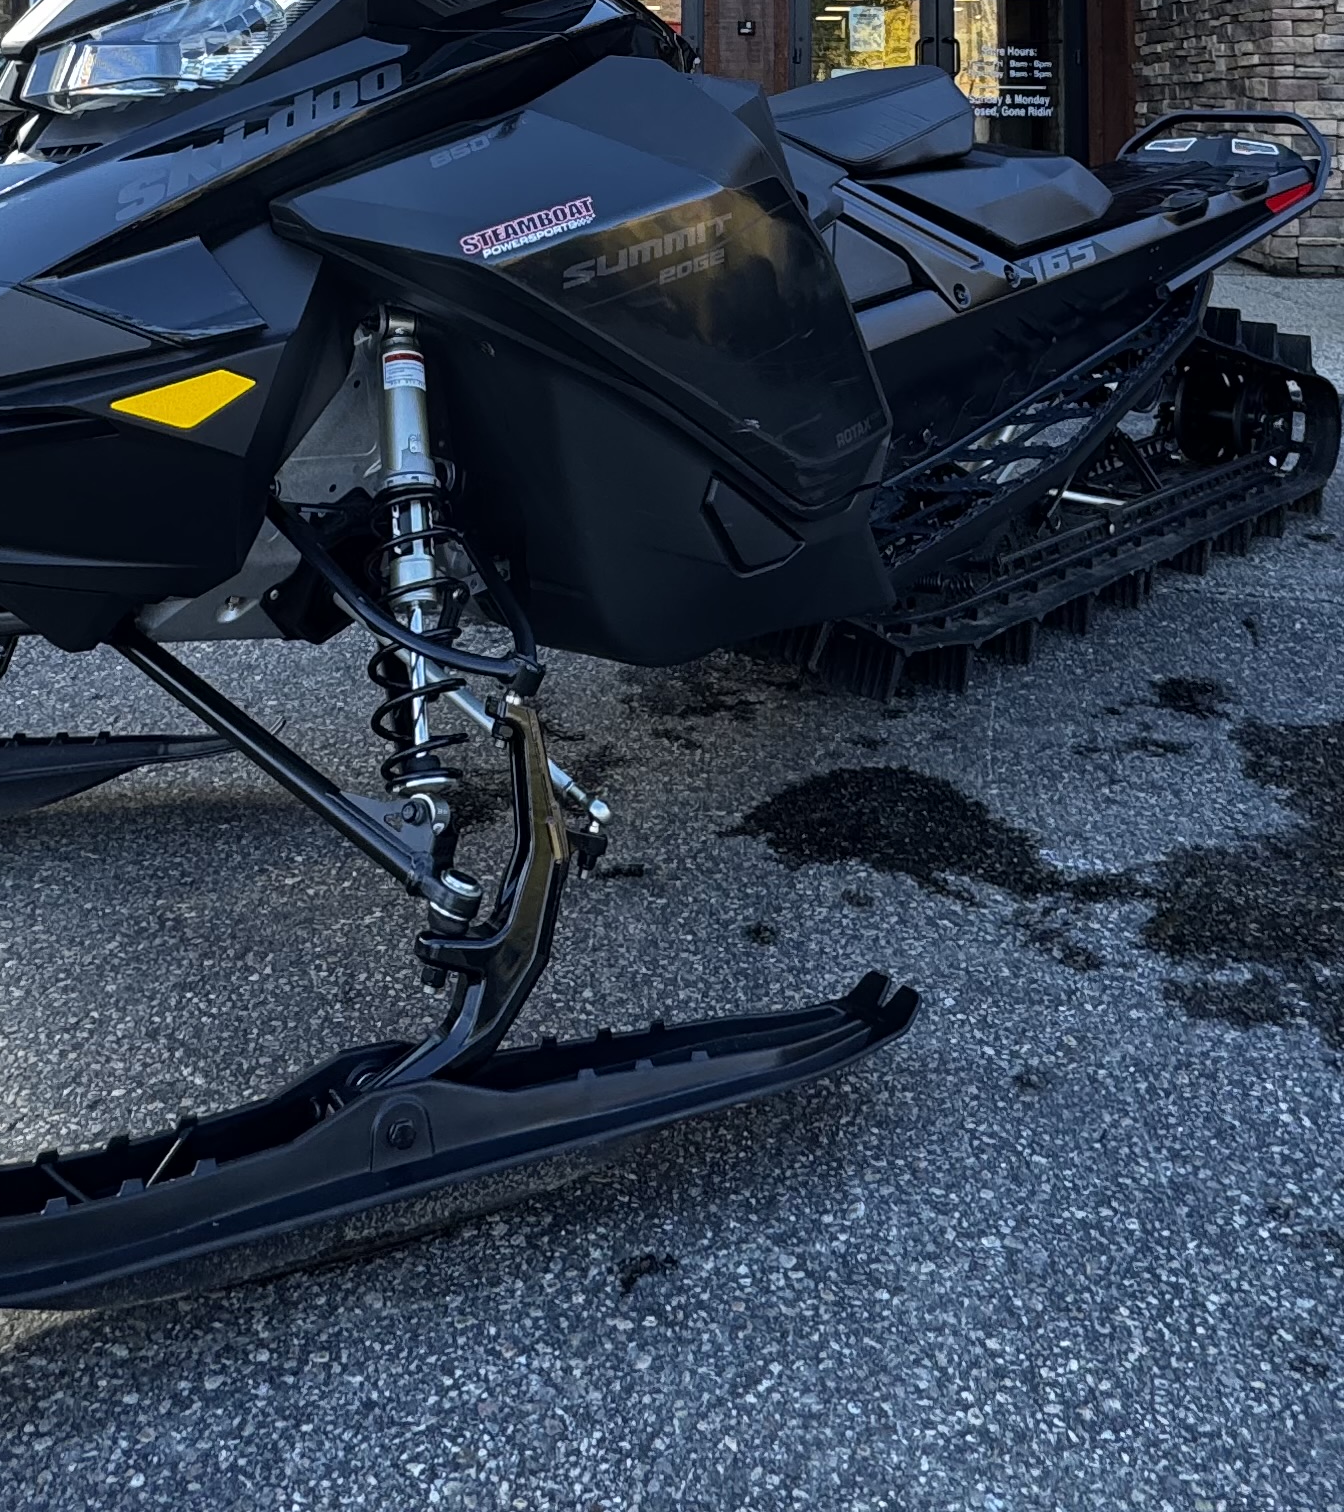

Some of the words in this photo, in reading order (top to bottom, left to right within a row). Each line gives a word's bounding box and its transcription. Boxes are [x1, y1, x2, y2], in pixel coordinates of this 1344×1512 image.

[1007, 46, 1038, 57] Hours:
[975, 107, 1000, 117] osed,
[1001, 106, 1026, 117] Gone
[1005, 94, 1012, 104] &
[1014, 94, 1051, 106] Monday
[430, 133, 490, 169] 850
[459, 195, 594, 255] STEAMBOAT
[482, 220, 578, 259] POWERSPORTS
[1029, 239, 1097, 285] 165
[835, 416, 872, 449] ROTAX
